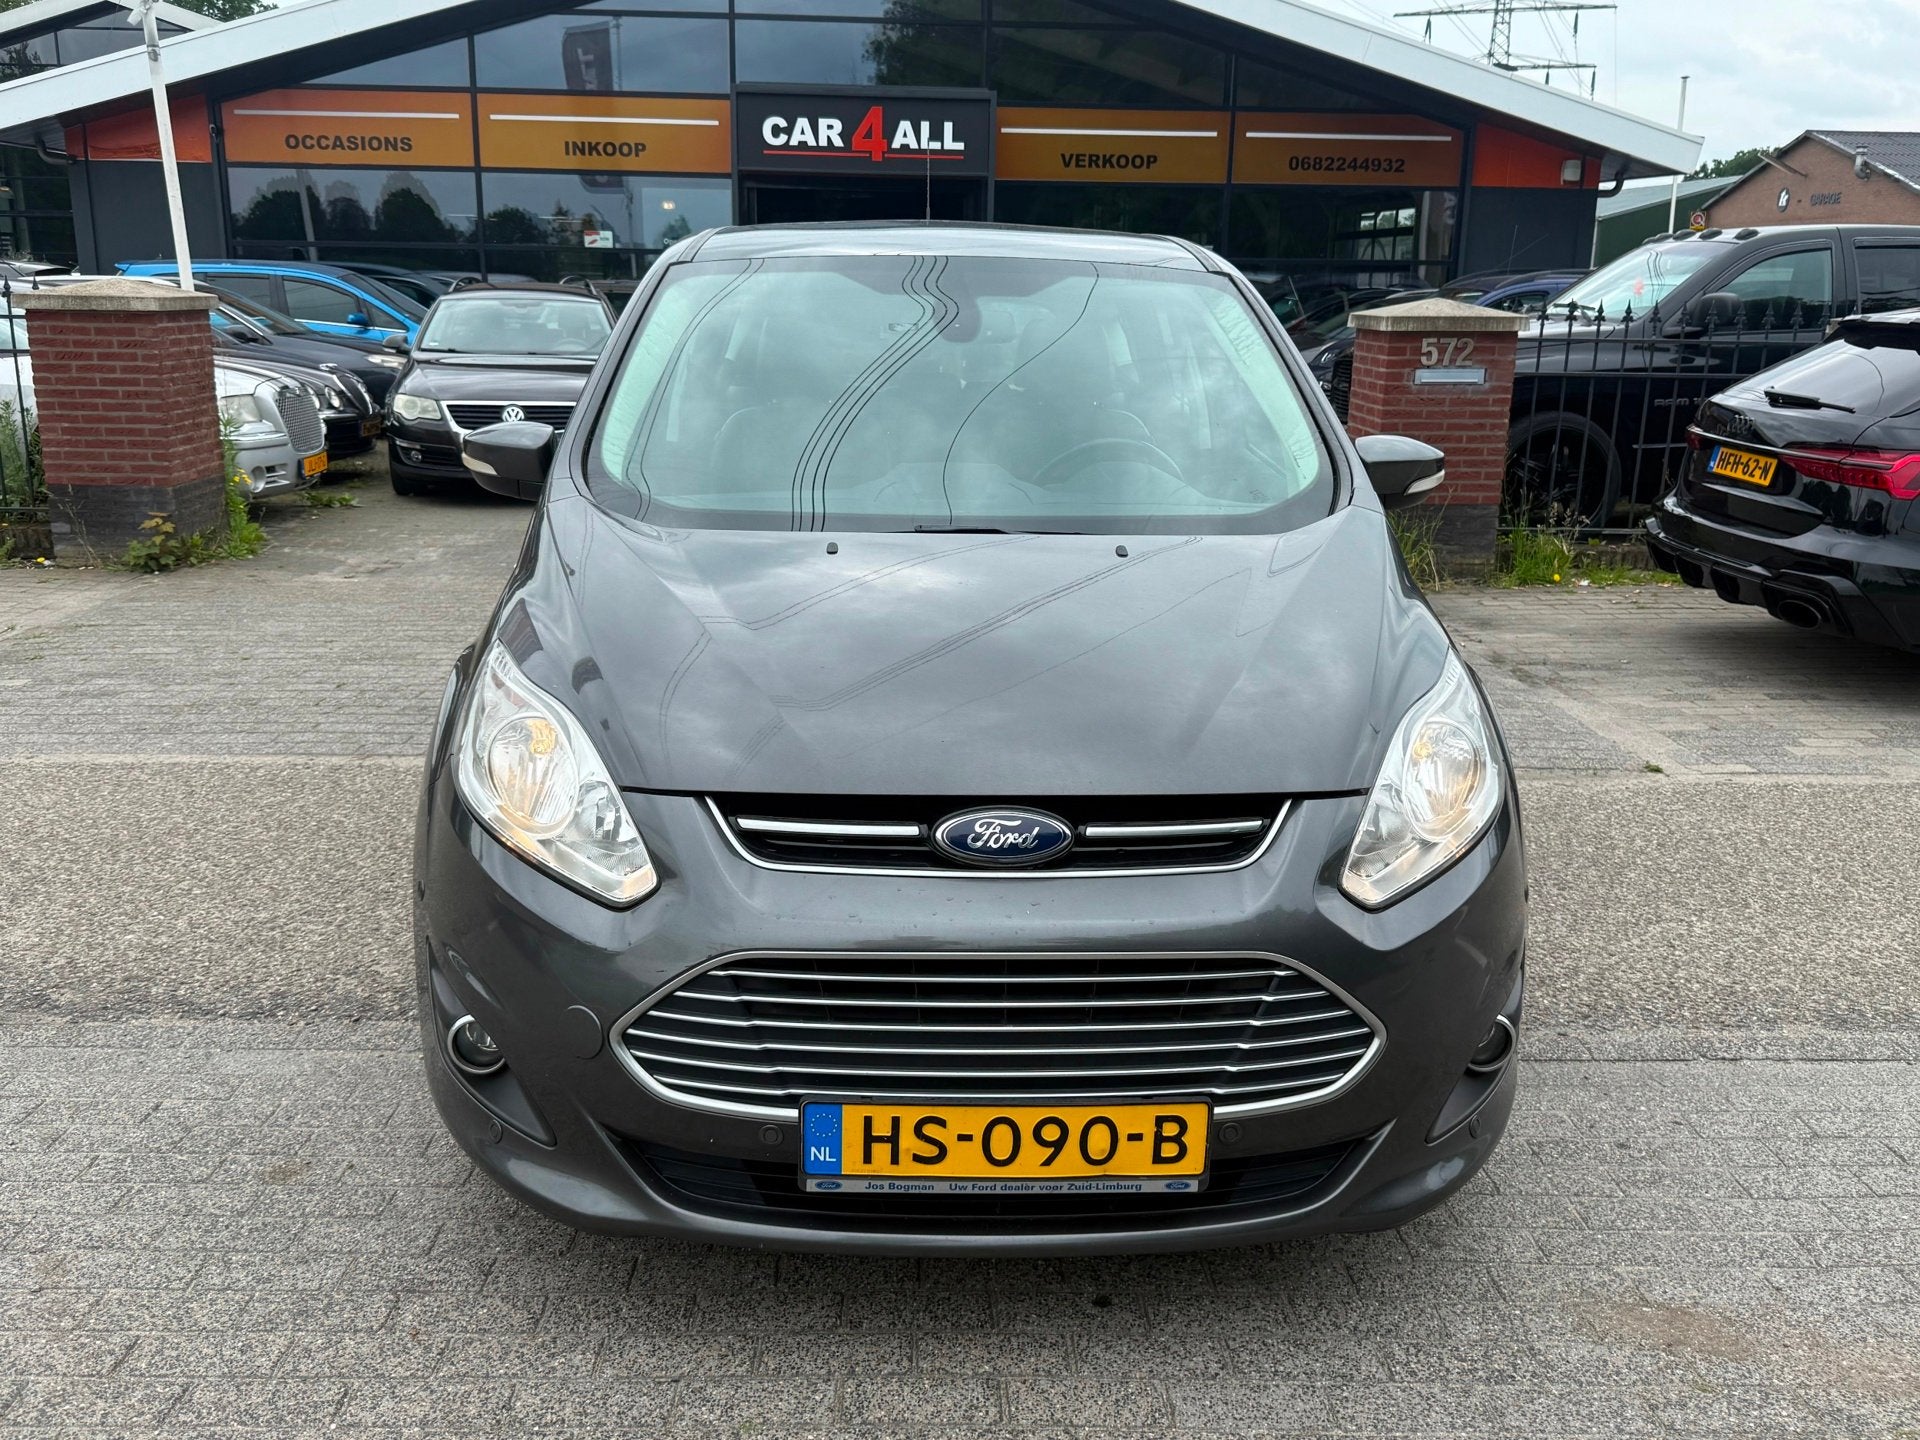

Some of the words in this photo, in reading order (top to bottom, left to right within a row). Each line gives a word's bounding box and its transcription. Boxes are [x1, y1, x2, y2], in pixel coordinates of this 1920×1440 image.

[762, 116, 845, 148] CAR
[852, 106, 888, 162] 4
[284, 134, 413, 152] OCCASIONS
[564, 141, 647, 157] INKOOP
[1060, 153, 1158, 170] VERKOOP
[1288, 156, 1405, 173] 0682244932
[1810, 192, 1842, 206] GARAGE
[1420, 337, 1474, 367] 572
[1716, 450, 1773, 481] HFH-62-N
[967, 818, 1040, 849] Ford
[863, 1115, 1188, 1167] HS-090-B
[810, 1147, 837, 1162] NL
[865, 1182, 885, 1190] Jos
[888, 1182, 935, 1192] Bogman
[949, 1183, 968, 1191] Uw
[971, 1183, 997, 1192] Ford
[1038, 1184, 1064, 1192] voor
[1067, 1182, 1142, 1191] Zuid-Limburg
